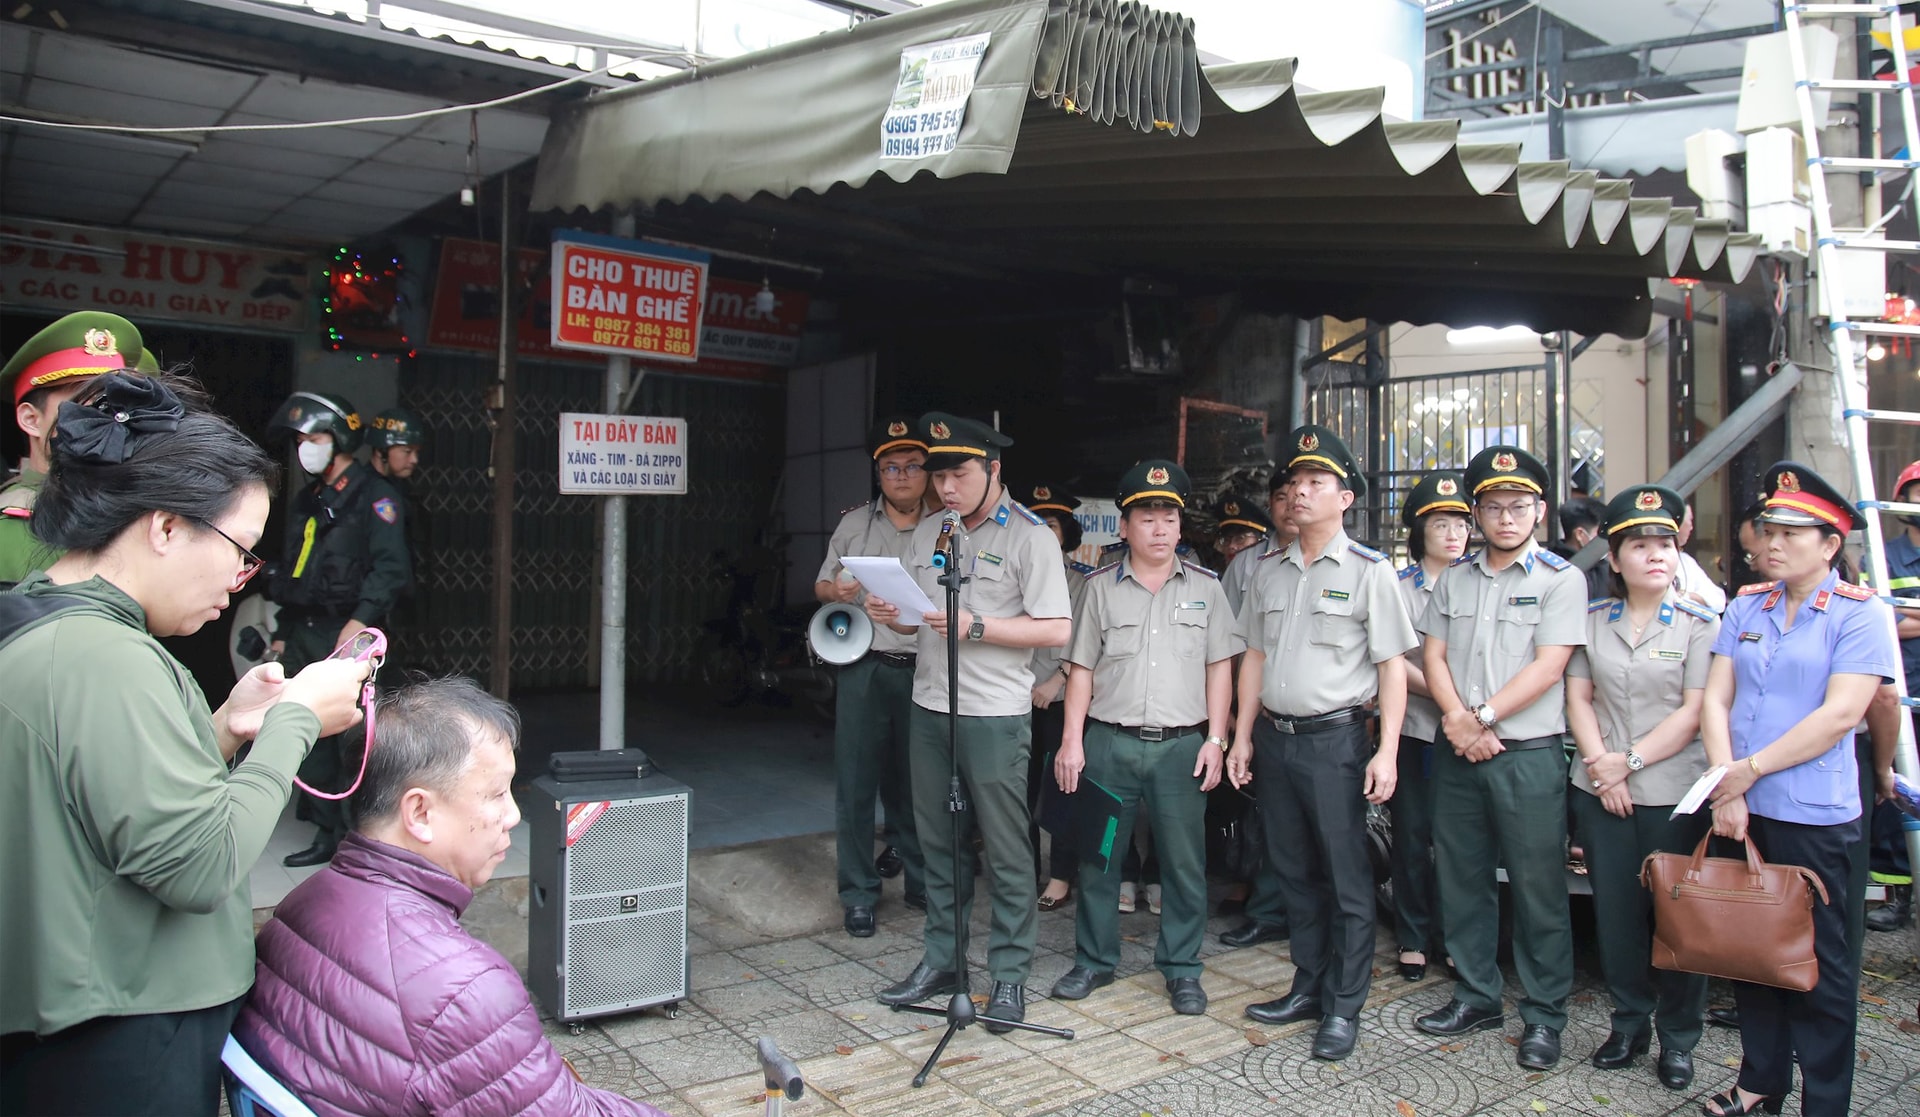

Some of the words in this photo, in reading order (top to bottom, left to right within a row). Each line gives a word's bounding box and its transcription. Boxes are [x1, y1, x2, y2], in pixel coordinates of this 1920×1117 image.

[886, 115, 917, 133] 0905
[921, 112, 942, 132] 745
[886, 138, 919, 156] 09194
[923, 135, 943, 154] 777
[122, 240, 252, 290] HUY
[568, 255, 623, 284] CHO
[631, 264, 695, 295] THUÊ
[19, 276, 79, 300] CÁC
[168, 293, 230, 316] GIÀY
[241, 301, 292, 322] DÉP
[567, 284, 627, 314] BÀN
[636, 295, 692, 323] GHẾ
[567, 312, 590, 328] LH:
[594, 316, 630, 333] 0987
[634, 321, 661, 337] 364
[665, 326, 690, 341] 381
[592, 330, 629, 347] 0977
[633, 336, 659, 350] 691
[664, 340, 690, 354] 569
[573, 421, 600, 446] TẠI
[605, 419, 638, 443] ĐÂY
[643, 421, 677, 445] BÁN
[567, 450, 597, 465] XĂNG
[607, 453, 626, 466] TIM
[636, 452, 650, 467] ĐÁ
[652, 454, 682, 468] ZIPPO
[573, 469, 587, 484] VÀ
[590, 470, 612, 485] CÁC
[614, 472, 637, 488] LOẠI
[640, 473, 650, 485] SI
[653, 471, 676, 486] GIÀY
[1073, 514, 1098, 532] CH
[1102, 514, 1116, 537] VỤ
